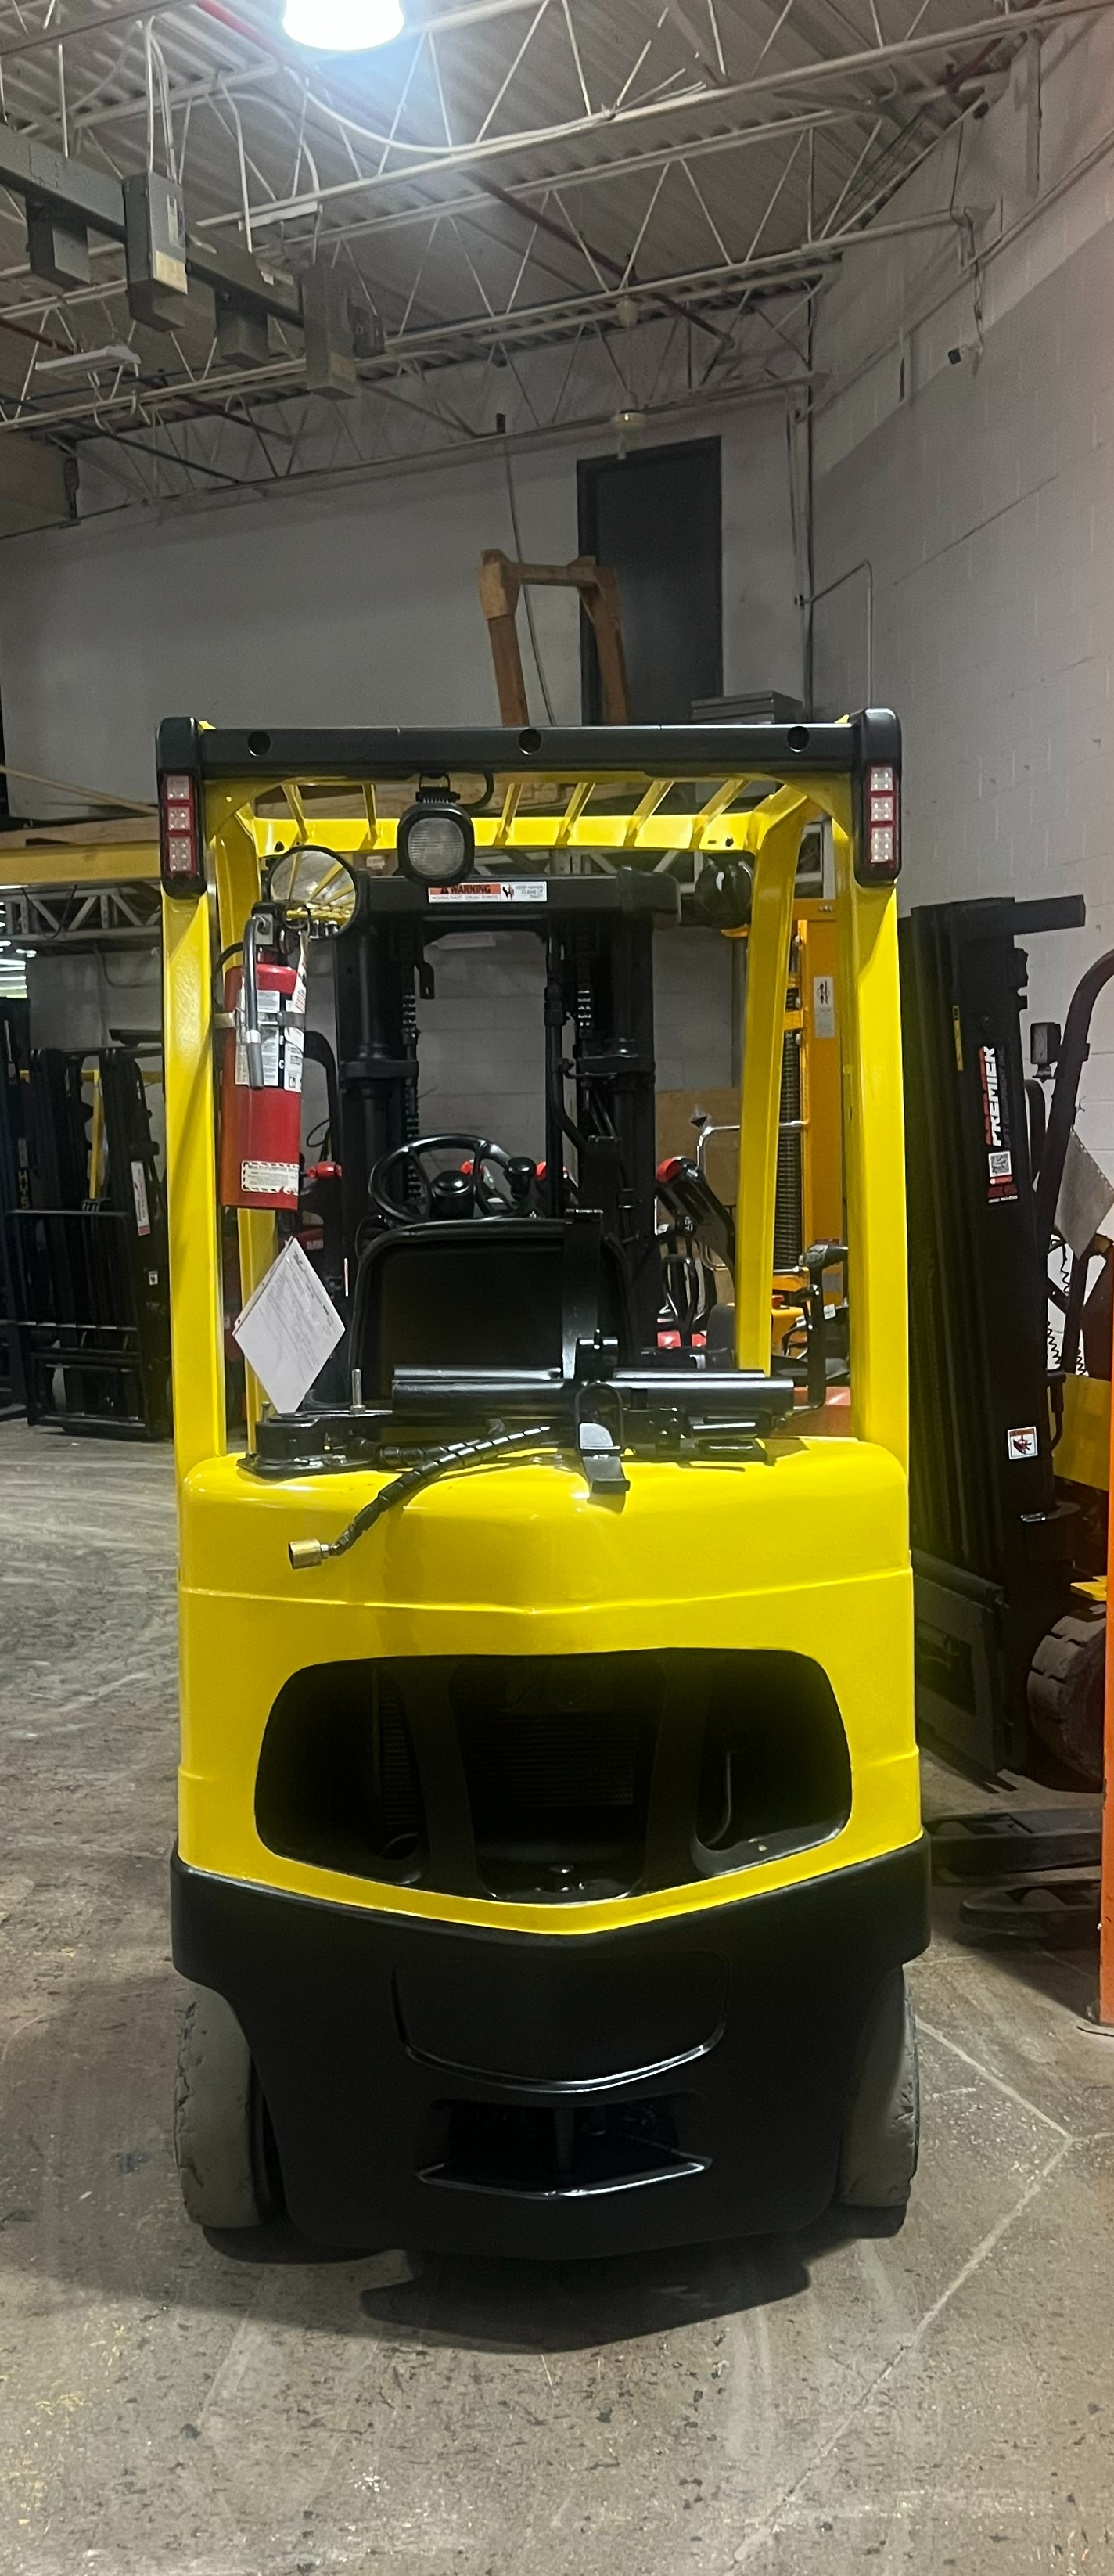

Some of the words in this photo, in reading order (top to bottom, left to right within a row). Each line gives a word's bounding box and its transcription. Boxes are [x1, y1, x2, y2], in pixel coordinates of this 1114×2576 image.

[451, 884, 491, 894] WARNING
[278, 1059, 285, 1069] C
[983, 1045, 1003, 1147] PREMIER
[18, 1170, 31, 1209] HYS
